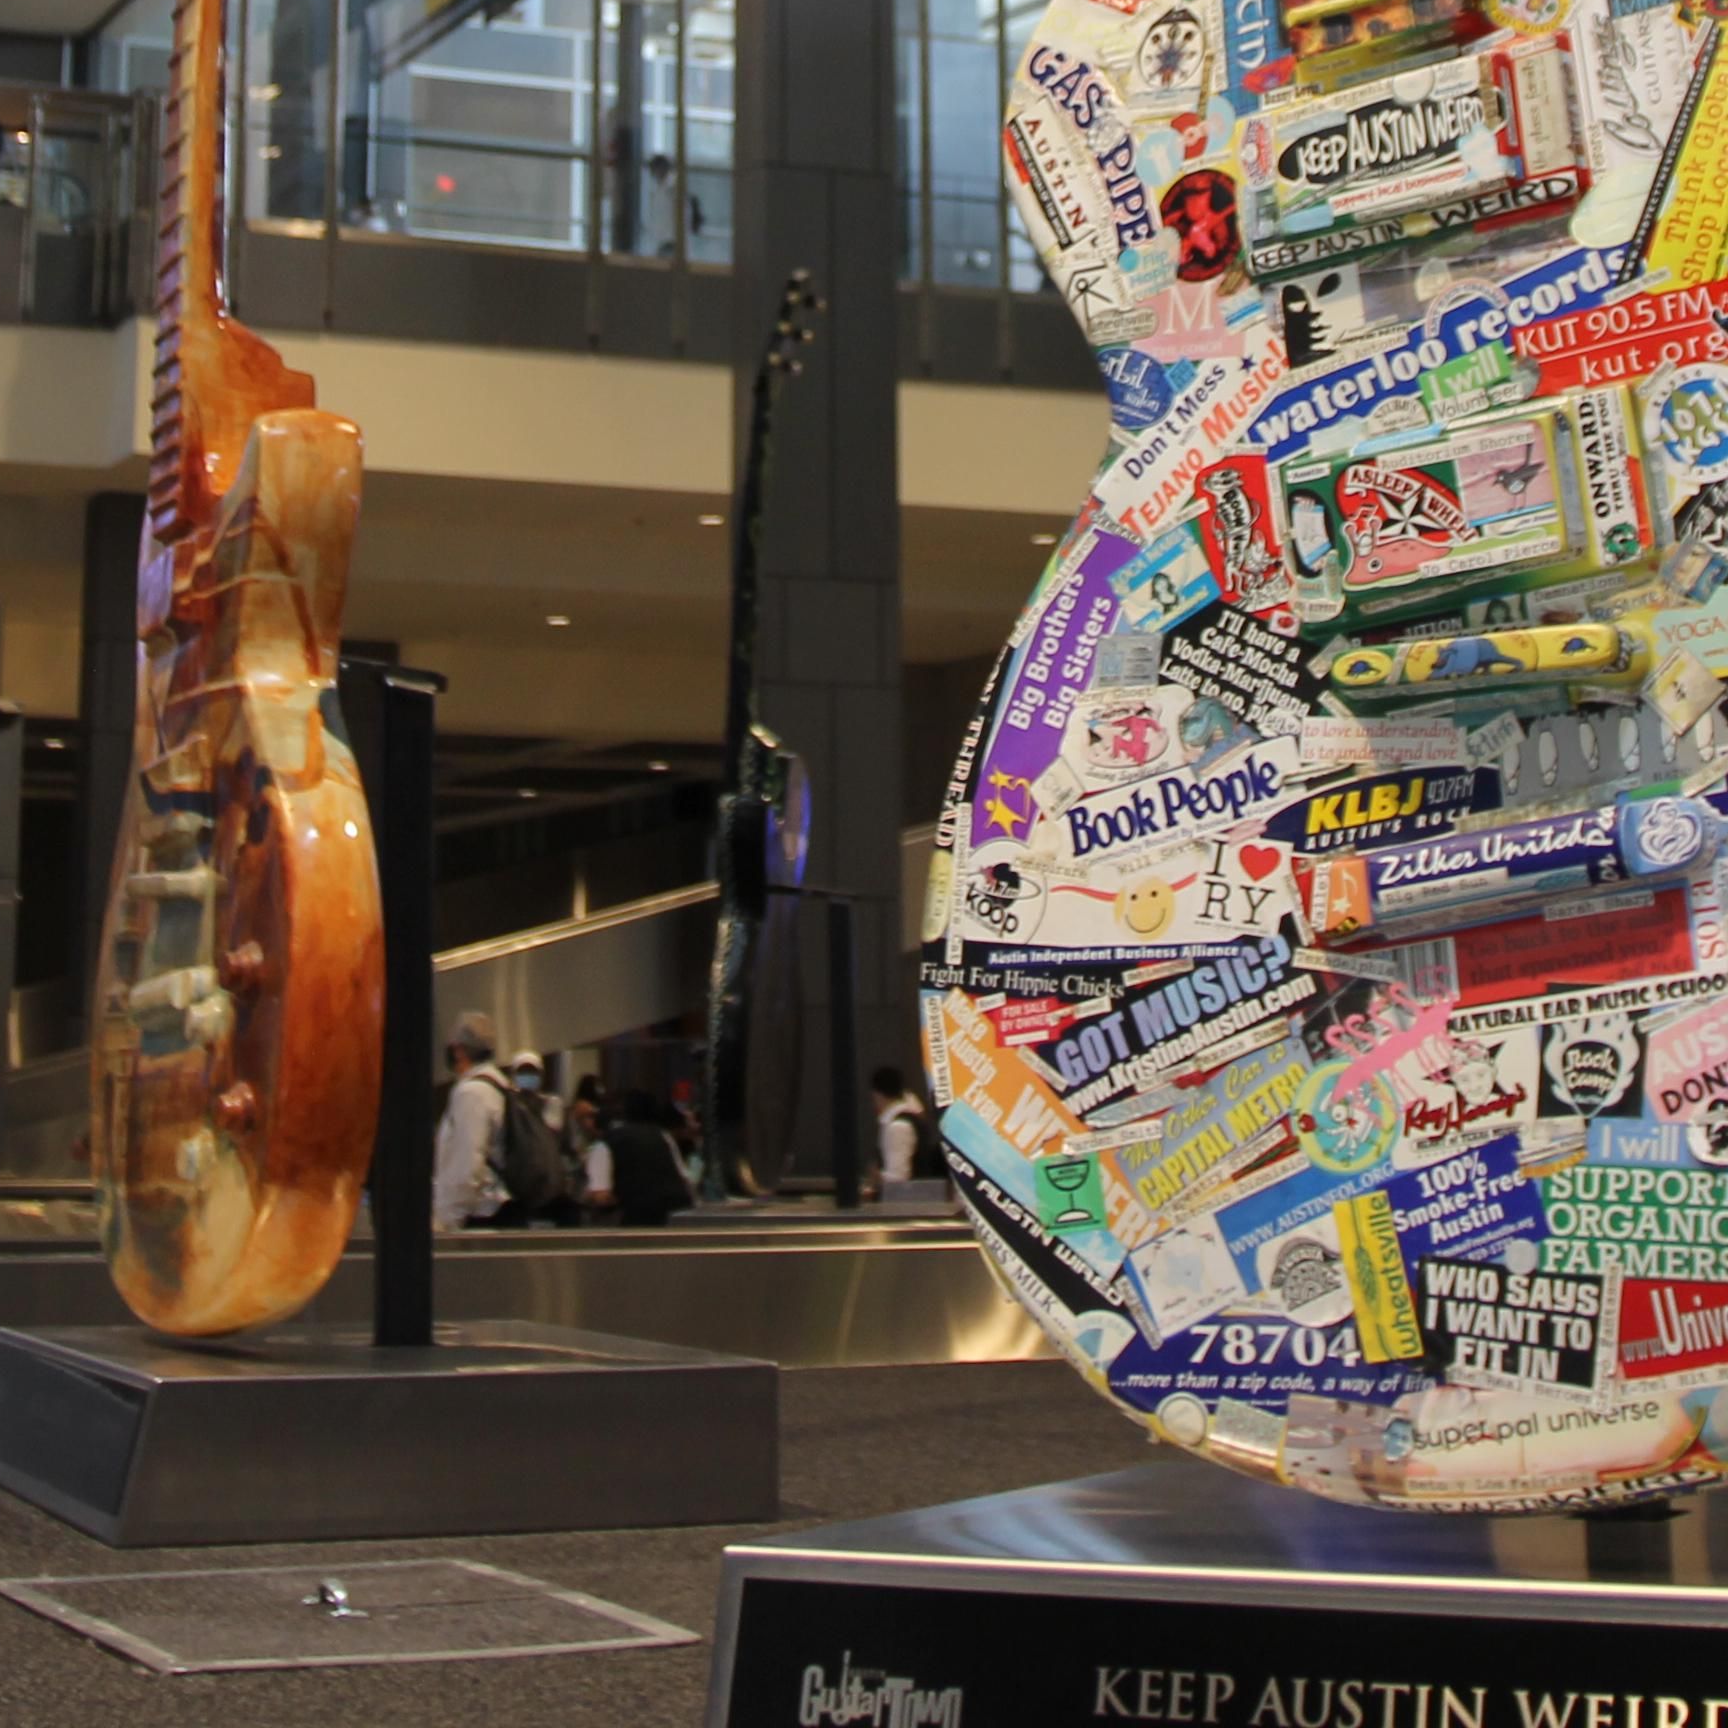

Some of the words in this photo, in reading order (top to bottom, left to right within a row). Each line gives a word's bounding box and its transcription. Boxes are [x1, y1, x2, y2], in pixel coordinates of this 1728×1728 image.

[1028, 45, 1106, 130] GAS
[1095, 134, 1158, 252] PIPE
[1296, 133, 1349, 183] KEEP
[1346, 103, 1425, 172] AUSTIN
[1022, 117, 1090, 231] AUSTIN
[1250, 241, 1310, 272] KEEP
[1314, 217, 1405, 263] AUSTIN
[1430, 175, 1573, 229] WEIRD
[1680, 216, 1722, 286] Shop
[1256, 335, 1449, 447] waterloo
[1456, 248, 1629, 354] records
[1516, 320, 1580, 358] KUT
[1585, 298, 1658, 342] 90.5
[1660, 286, 1713, 323] FM
[1447, 345, 1503, 387] will
[1123, 419, 1181, 482] Don't
[1174, 362, 1227, 424] Mess
[1348, 466, 1415, 498] ASLEEP
[1426, 498, 1480, 543] WHEEL
[1025, 569, 1086, 684] Brothers
[1061, 594, 1113, 690] Sisters
[1247, 623, 1289, 657] have
[1288, 647, 1303, 665] a
[1659, 612, 1725, 647] YOGA
[1171, 636, 1312, 721] Vodka-Marijuana
[1200, 624, 1301, 689] Cafe-Mocha
[1006, 682, 1049, 732] Big
[1043, 687, 1082, 732] Big
[1304, 724, 1320, 739] to
[1321, 722, 1354, 739] love
[1355, 724, 1461, 745] understanding
[1303, 743, 1316, 761] is
[1317, 745, 1334, 761] to
[1334, 742, 1423, 763] understand
[1424, 745, 1459, 761] love
[1305, 777, 1426, 835] KLBJ
[1305, 818, 1402, 852] AUSTIN'S
[1416, 805, 1473, 830] ROCK
[1206, 840, 1226, 878] I
[1376, 851, 1478, 888] Zilker
[1478, 821, 1587, 866] United
[964, 882, 1021, 937] koop
[1196, 880, 1276, 927] RY
[920, 962, 966, 990] Fight
[970, 968, 1004, 990] For
[1004, 970, 1060, 998] Hippie
[1060, 971, 1127, 1000] Chicks
[987, 949, 1029, 967] Austin
[1030, 947, 1115, 966] Independent
[1115, 946, 1179, 963] Business
[1181, 942, 1240, 960] Alliance
[1000, 1001, 1021, 1017] FOR
[1022, 999, 1049, 1015] SALE
[1054, 1010, 1134, 1088] GOT
[1130, 934, 1294, 1046] MUSIC?
[1446, 1001, 1537, 1033] NATURAL
[1542, 995, 1583, 1018] EAR
[1586, 983, 1651, 1012] MUSIC
[1135, 1121, 1236, 1212] CAPITAL
[1224, 1062, 1309, 1145] METRO
[1601, 1125, 1613, 1160] I
[1618, 1124, 1681, 1164] will
[1393, 1169, 1529, 1234] Smoke-Free
[1417, 1150, 1489, 1199] 100%
[1429, 1203, 1506, 1246] Austin
[1424, 1261, 1501, 1303] WHO
[1503, 1271, 1601, 1317] SAYS
[1188, 1322, 1361, 1369] 78704
[1425, 1297, 1440, 1332] I
[1443, 1300, 1546, 1347] WANT
[1551, 1311, 1595, 1352] TO
[1175, 1371, 1220, 1391] than
[1223, 1375, 1236, 1391] a
[1237, 1373, 1267, 1395] zip
[1270, 1373, 1316, 1394] code,
[1321, 1378, 1336, 1392] a
[1337, 1377, 1376, 1396] way
[1379, 1373, 1401, 1393] of
[1454, 1336, 1511, 1376] FIT
[1518, 1344, 1561, 1384] IN
[1413, 1418, 1489, 1450] super
[1495, 1416, 1543, 1448] pal
[1548, 1396, 1660, 1434] universe
[1092, 1665, 1237, 1725] KEEP
[1248, 1675, 1488, 1728] AUSTIN
